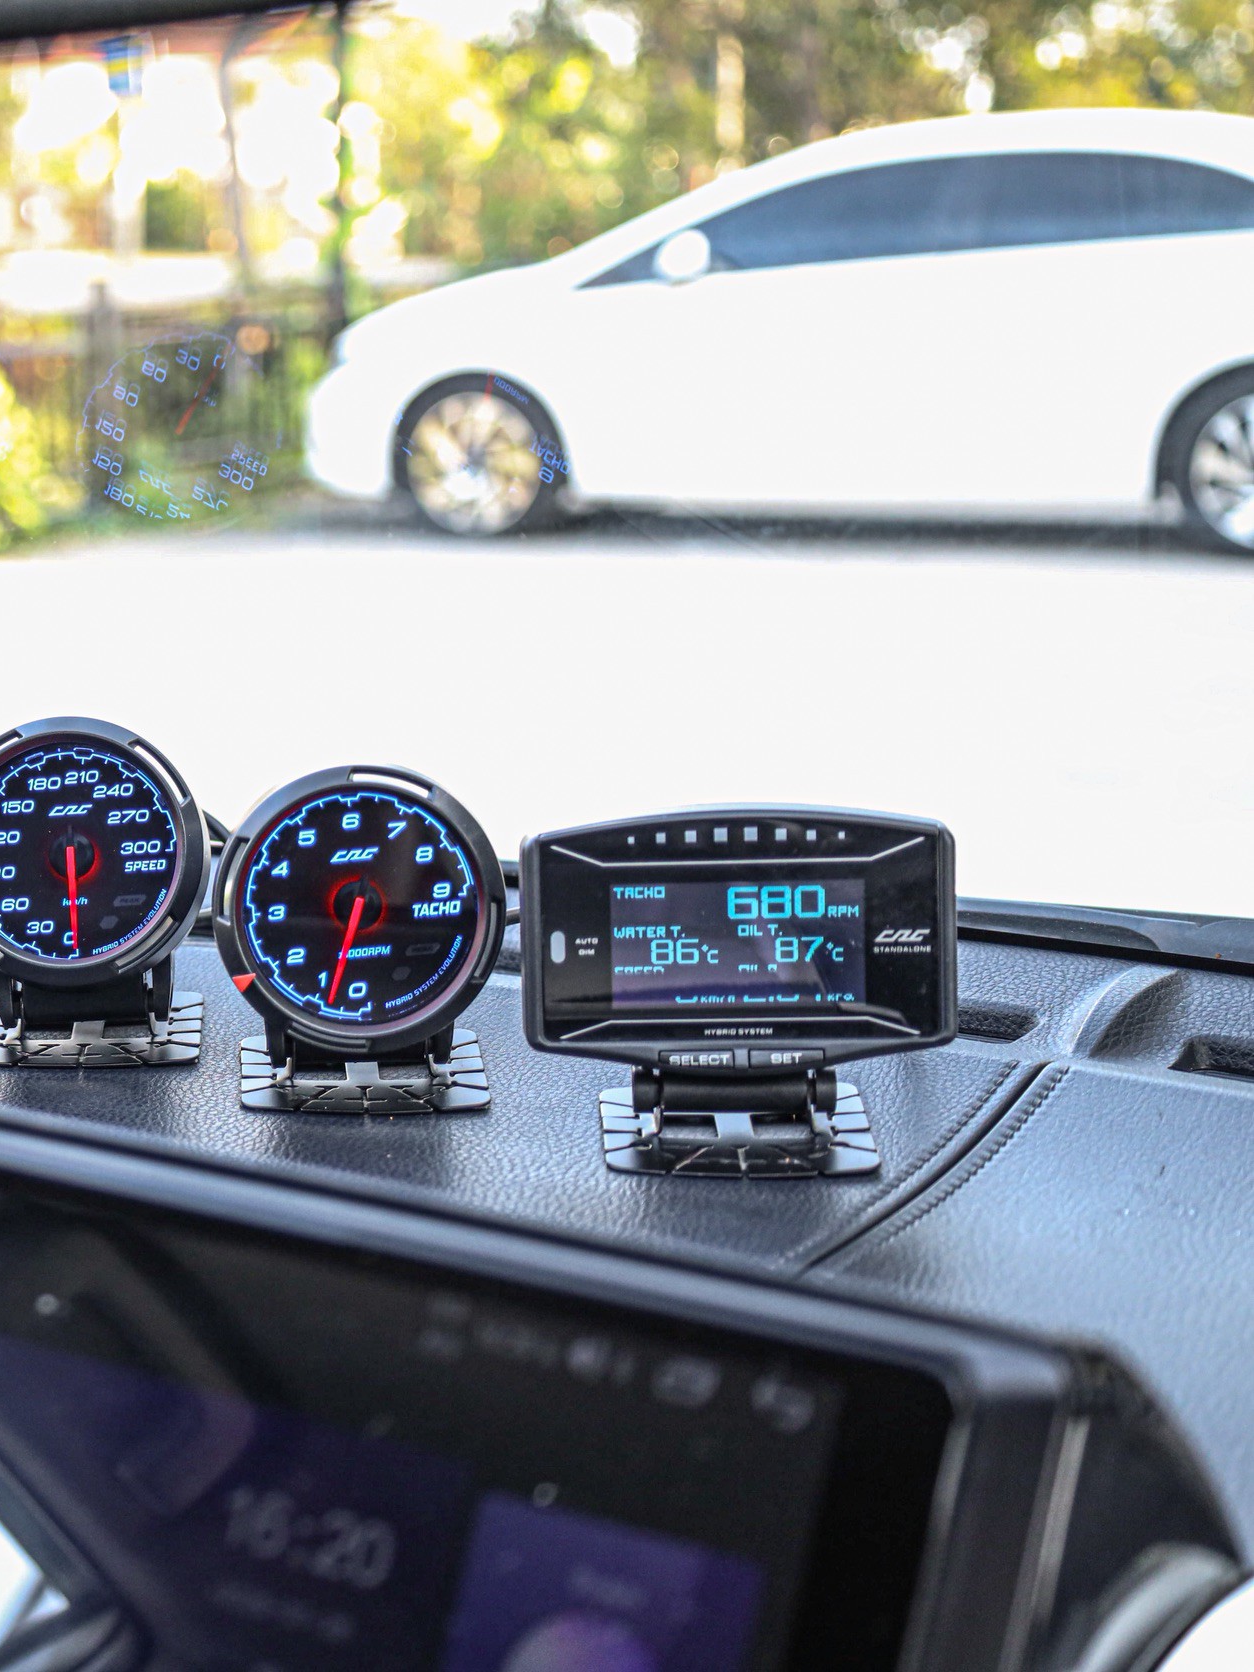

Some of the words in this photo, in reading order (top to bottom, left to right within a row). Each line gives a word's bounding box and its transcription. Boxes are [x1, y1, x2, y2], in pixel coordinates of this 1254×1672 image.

[28, 777, 61, 791] 180
[65, 770, 99, 785] 210
[92, 784, 134, 798] 240
[2, 800, 34, 814] 150
[107, 810, 150, 824] 270
[342, 814, 360, 830] 6
[298, 830, 316, 845] 5
[388, 822, 406, 839] 7
[120, 840, 161, 855] 300
[415, 846, 434, 862] 8
[124, 860, 166, 872] SPEED
[271, 860, 289, 876] 4
[433, 882, 451, 898] 9
[613, 886, 666, 899] TACHO
[1, 898, 30, 911] 60
[62, 896, 88, 906] k/h
[727, 884, 826, 920] 680
[827, 905, 859, 918] RPM
[268, 906, 285, 920] 3
[412, 900, 460, 918] TACHO
[26, 920, 54, 934] 30
[92, 941, 118, 955] HYBRID
[119, 924, 144, 944] SYSTEM
[143, 888, 166, 924] EVOLUTION
[614, 926, 666, 938] WATER
[670, 926, 686, 938] T.
[738, 924, 763, 936] OIL
[768, 924, 782, 936] T.
[286, 948, 306, 964] 2
[578, 948, 595, 956] DIM
[650, 939, 700, 965] 86
[775, 936, 824, 962] 87
[873, 944, 932, 954] STANDALONE
[385, 992, 413, 1008] HYBRID
[414, 974, 439, 996] SYSTEM
[438, 935, 462, 975] EVOLUTION
[318, 972, 328, 988] 1
[348, 982, 367, 998] 0
[704, 1028, 736, 1036] HYBRID
[738, 1027, 774, 1036] SYSTEM
[668, 1053, 730, 1066] SELECT
[770, 1052, 802, 1065] SET
